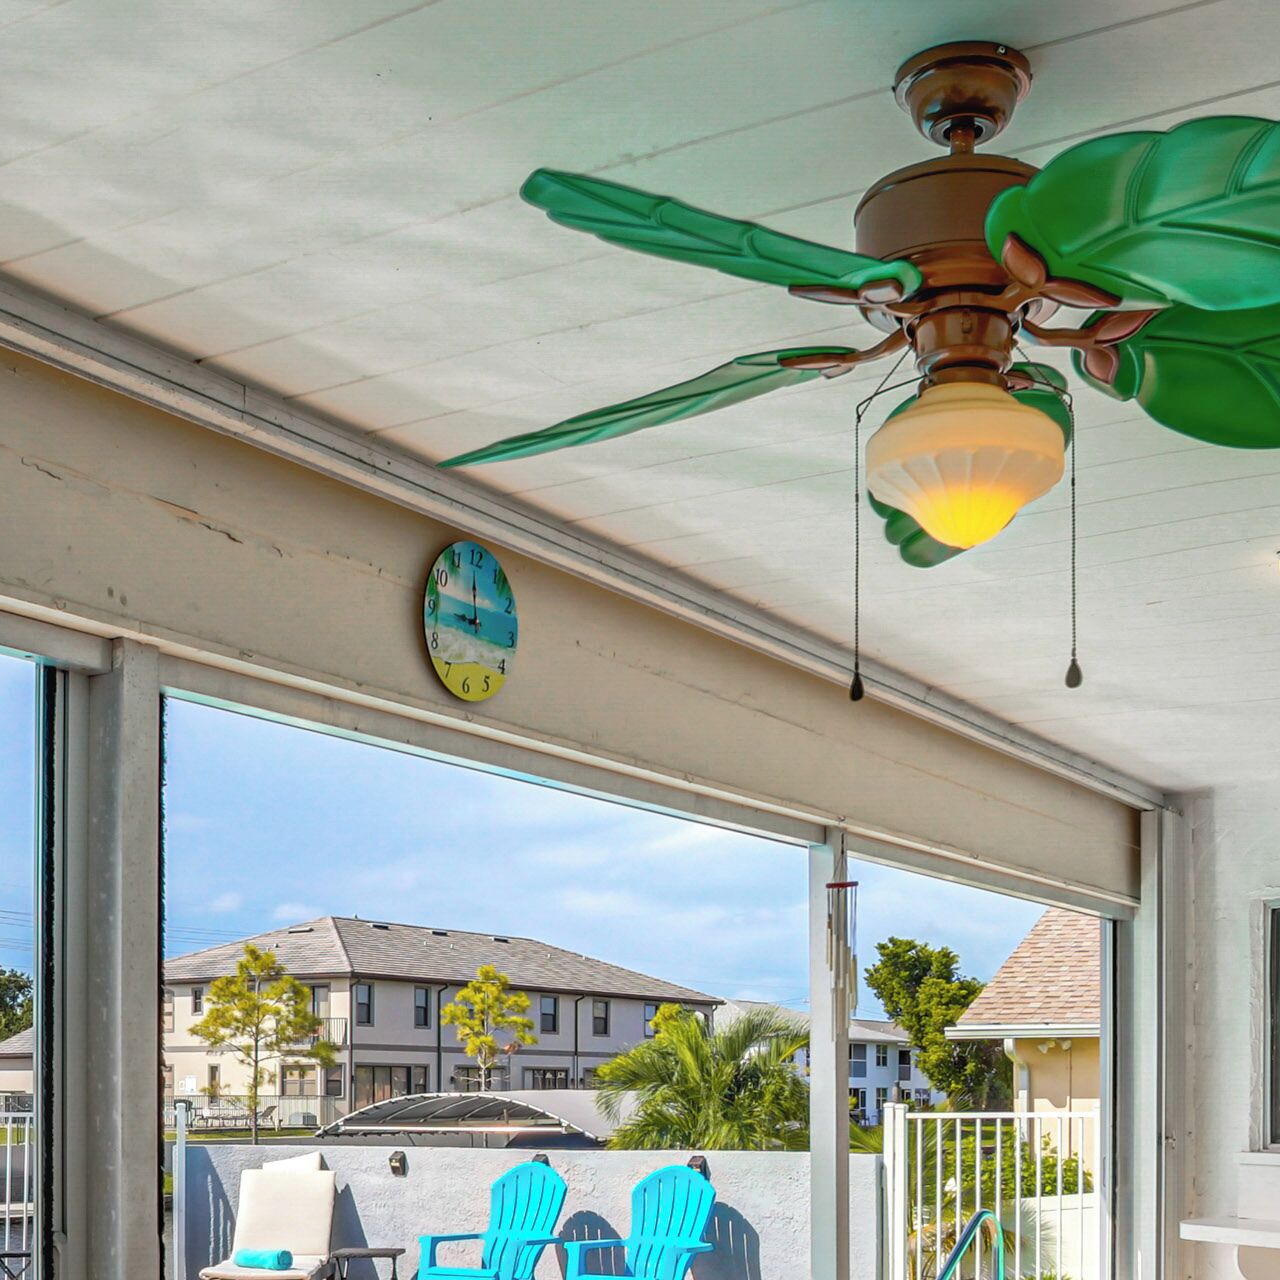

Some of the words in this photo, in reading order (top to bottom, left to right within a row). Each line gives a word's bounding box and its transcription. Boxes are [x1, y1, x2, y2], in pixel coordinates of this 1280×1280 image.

[451, 549, 461, 568] 11
[470, 549, 483, 568] 12
[435, 568, 448, 587] 10
[428, 598, 436, 616] 9
[504, 597, 512, 614] 2
[431, 631, 438, 649] 8
[508, 631, 515, 648] 3
[444, 661, 452, 678] 7
[497, 658, 506, 675] 4
[462, 676, 470, 694] 6
[482, 675, 490, 692] 5
